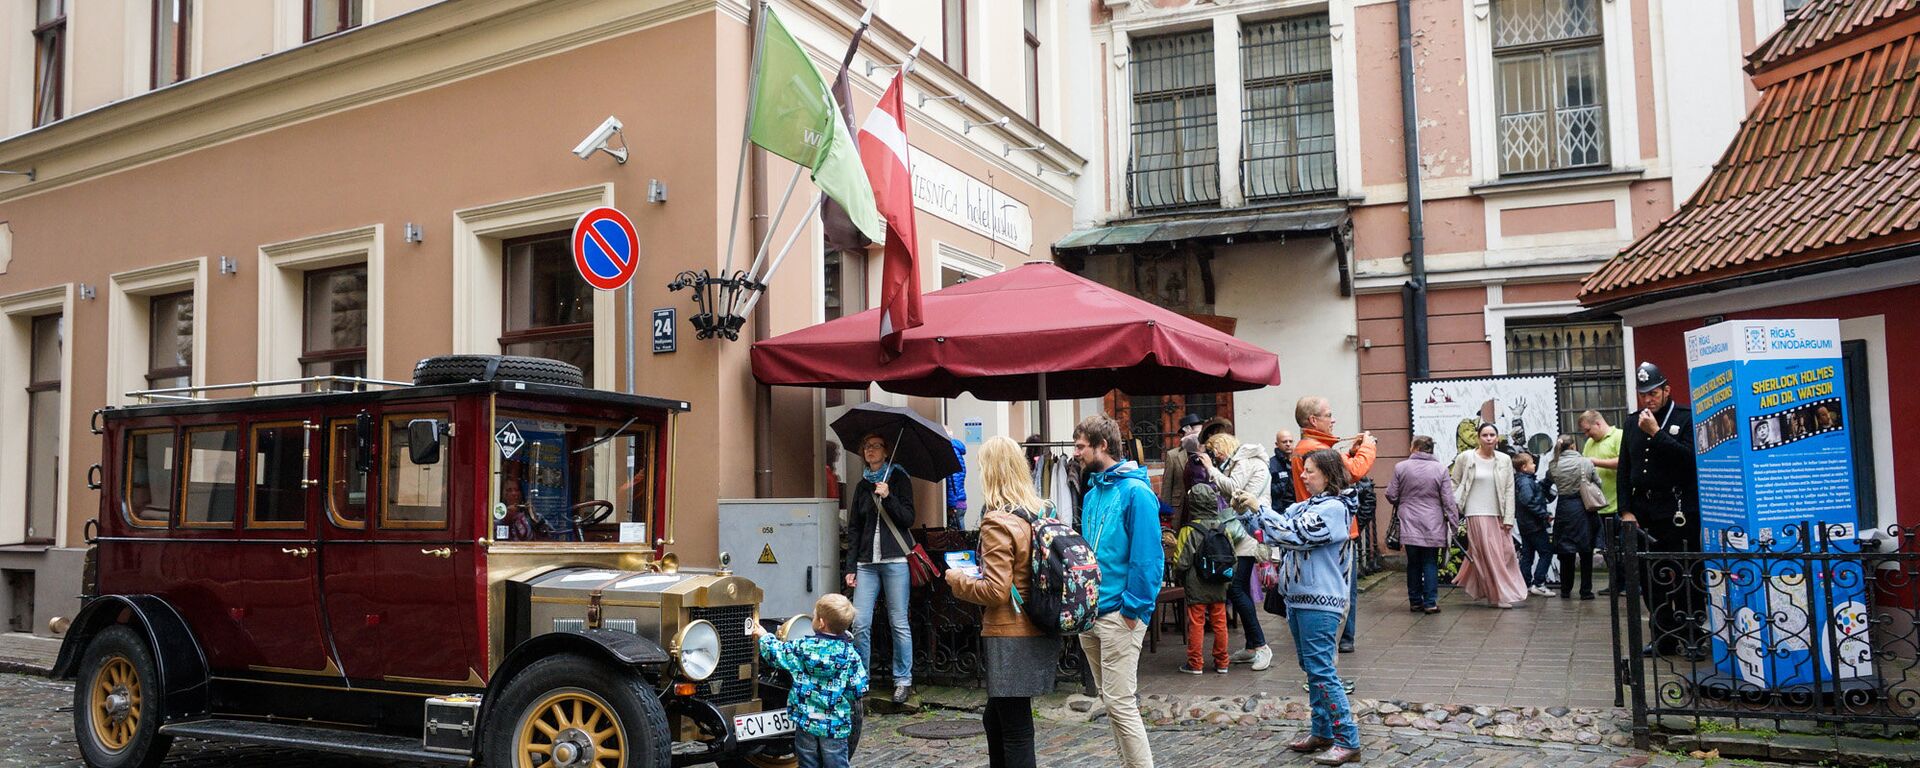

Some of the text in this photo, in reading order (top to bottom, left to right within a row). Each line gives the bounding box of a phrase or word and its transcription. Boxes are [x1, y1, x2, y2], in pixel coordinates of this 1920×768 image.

[966, 177, 991, 230] hotel
[655, 318, 672, 337] 24
[1770, 327, 1796, 338] RĪGAS
[1771, 338, 1833, 350] KINODĀRGUMI
[1752, 366, 1835, 395] SHERLOCK HOLMES
[1760, 382, 1833, 409] AND DR. WATSON
[503, 431, 517, 444] 70
[762, 526, 774, 534] 058
